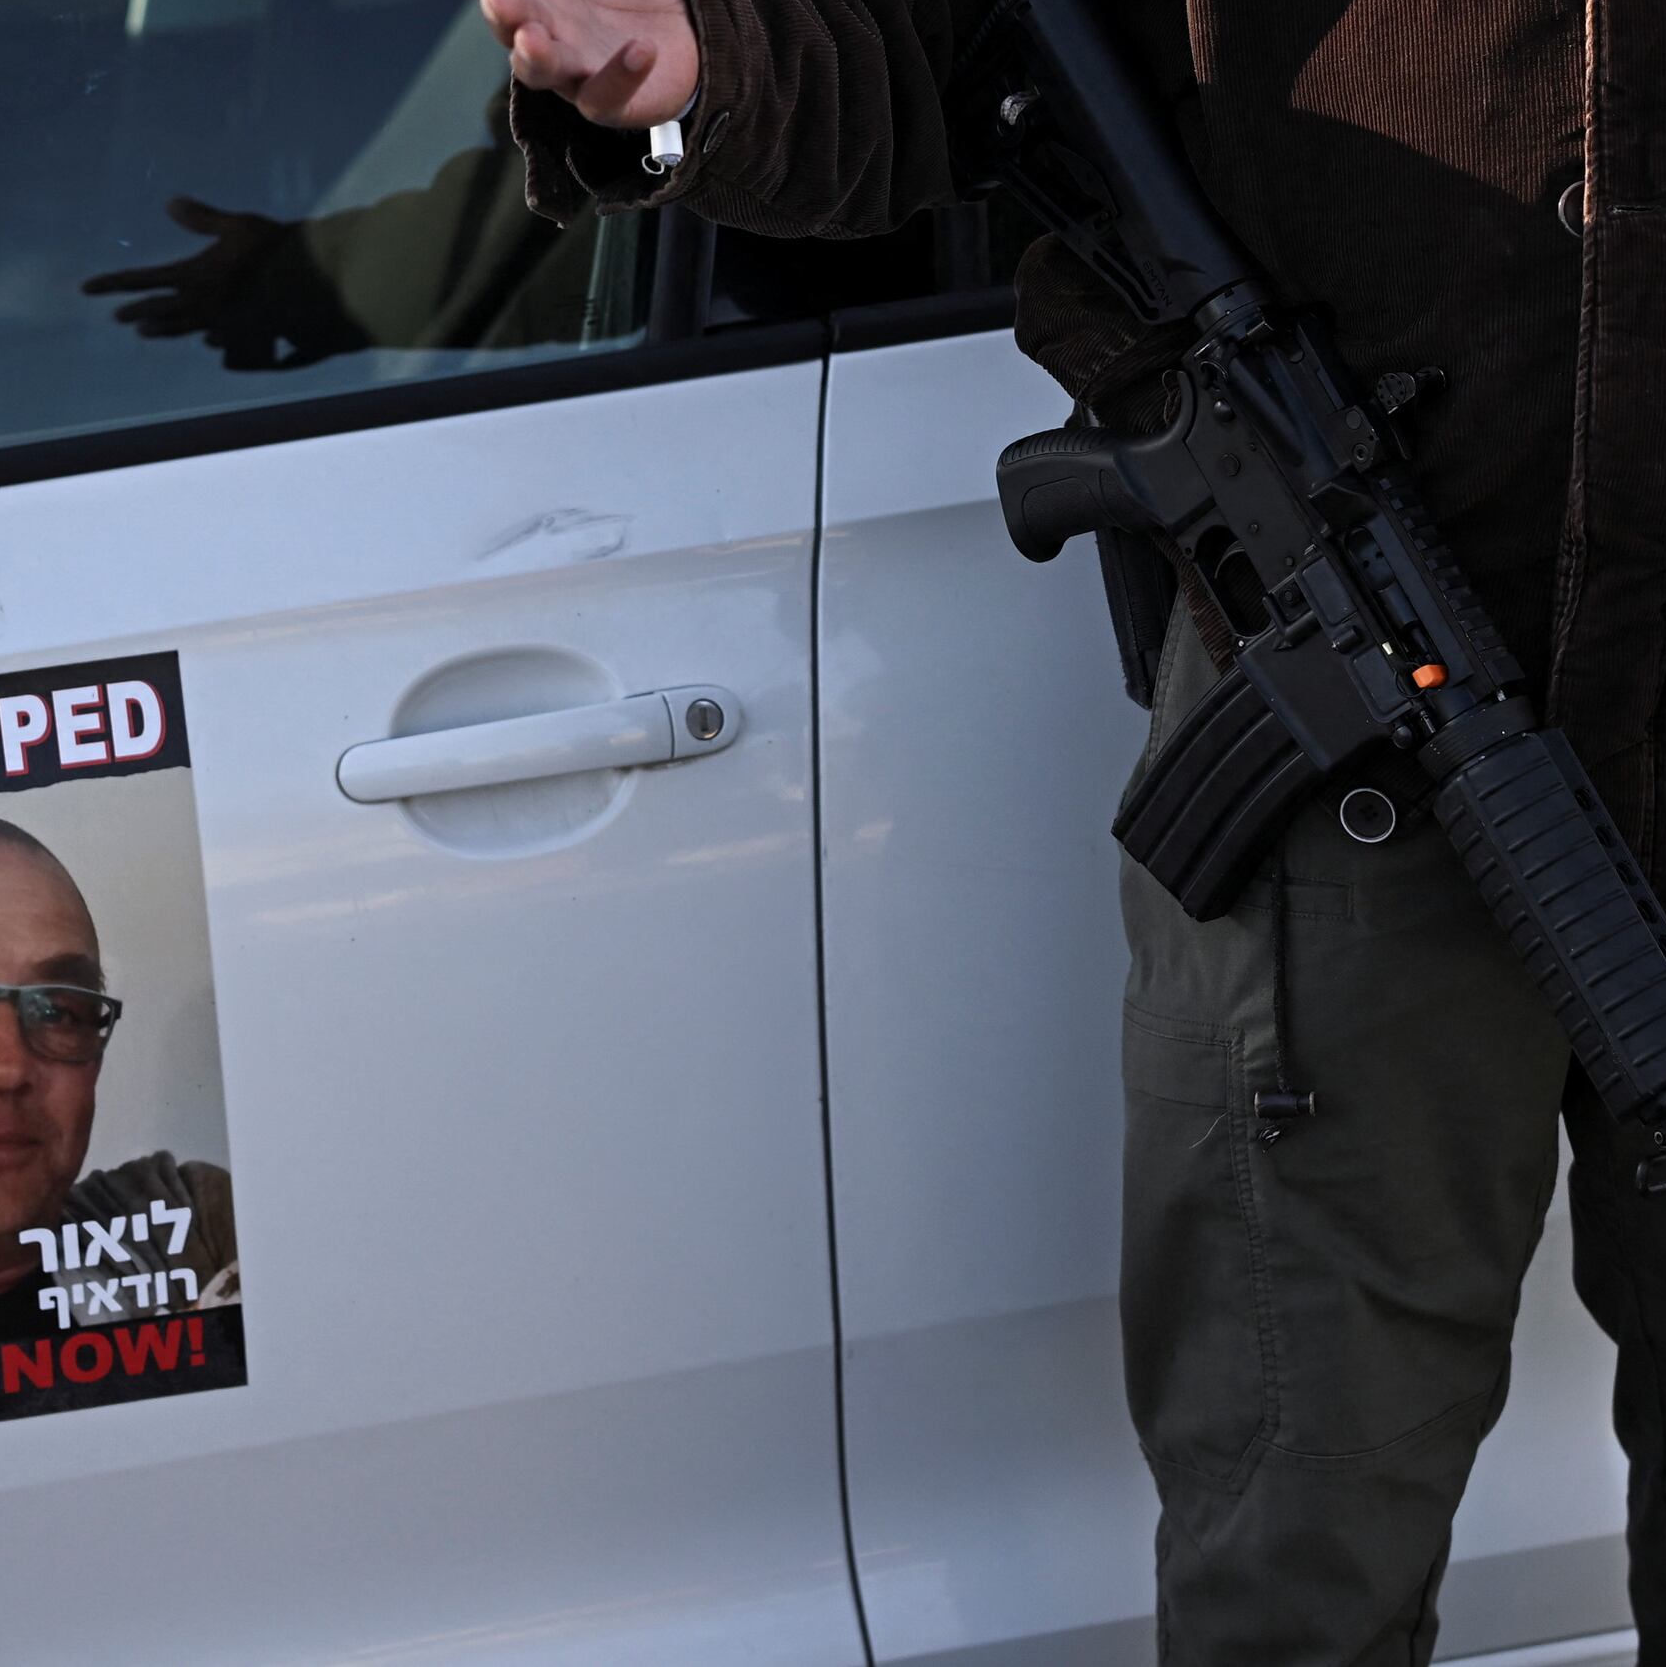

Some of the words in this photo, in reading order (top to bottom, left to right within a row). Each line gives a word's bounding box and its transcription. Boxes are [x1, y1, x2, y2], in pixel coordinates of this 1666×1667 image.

[19, 1199, 192, 1273] ליאור
[38, 1268, 199, 1330] רודאיף
[2, 1317, 207, 1394] NOW!
